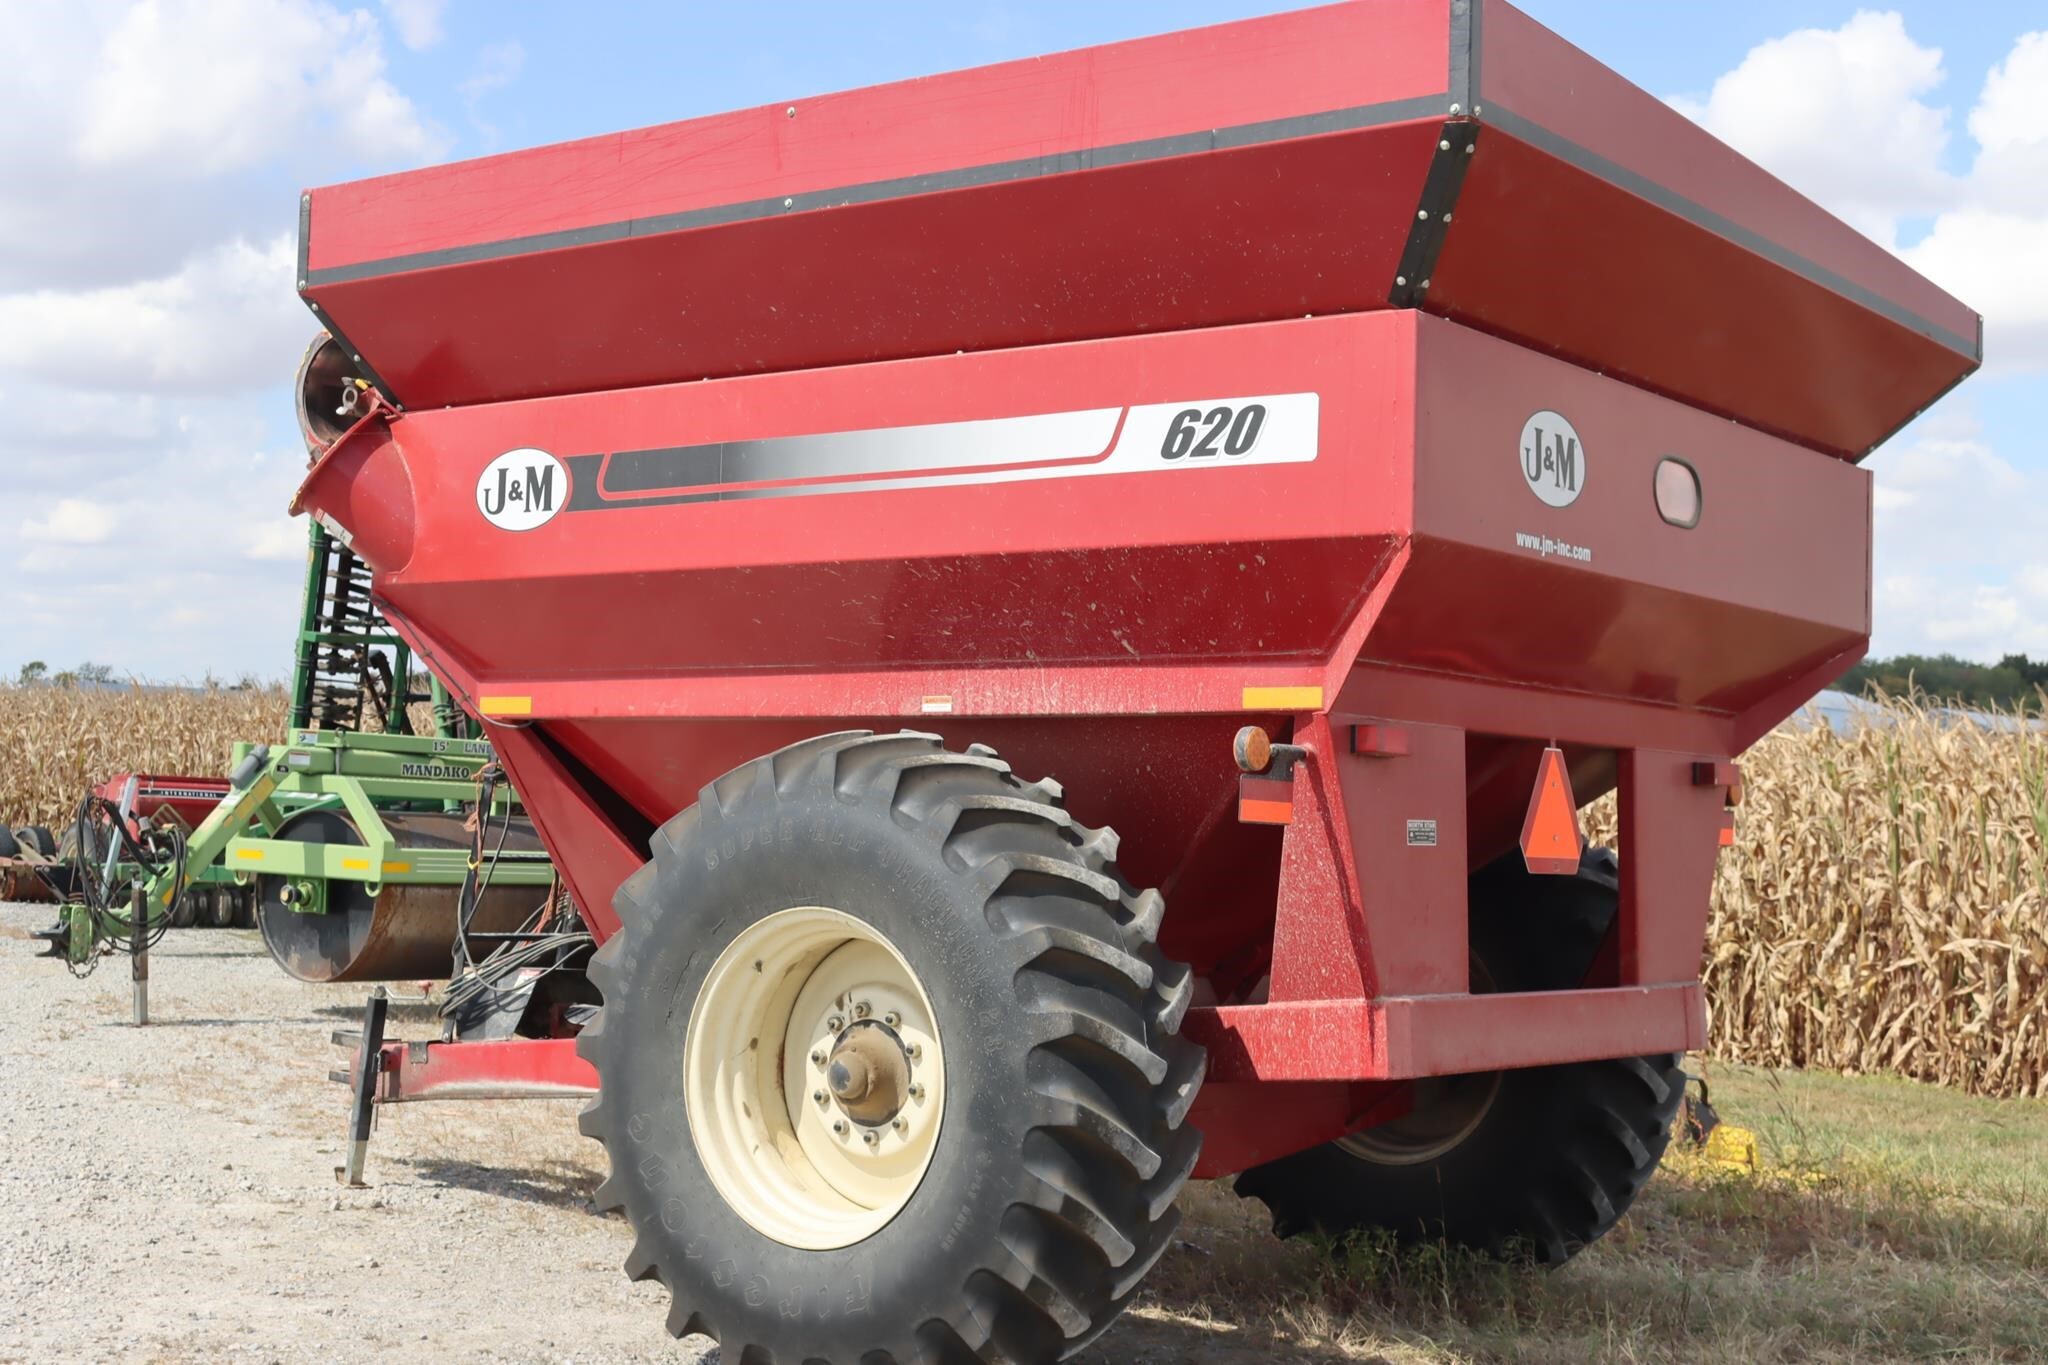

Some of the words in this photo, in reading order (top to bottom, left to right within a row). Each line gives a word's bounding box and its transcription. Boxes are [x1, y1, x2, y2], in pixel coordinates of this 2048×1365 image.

[1161, 404, 1266, 460] 620
[1525, 427, 1577, 492] J&M
[483, 464, 555, 515] J&M
[1516, 532, 1592, 562] www.jm-inc.com
[402, 764, 470, 778] MANDAKO
[160, 790, 217, 798] INTERNATIONAL
